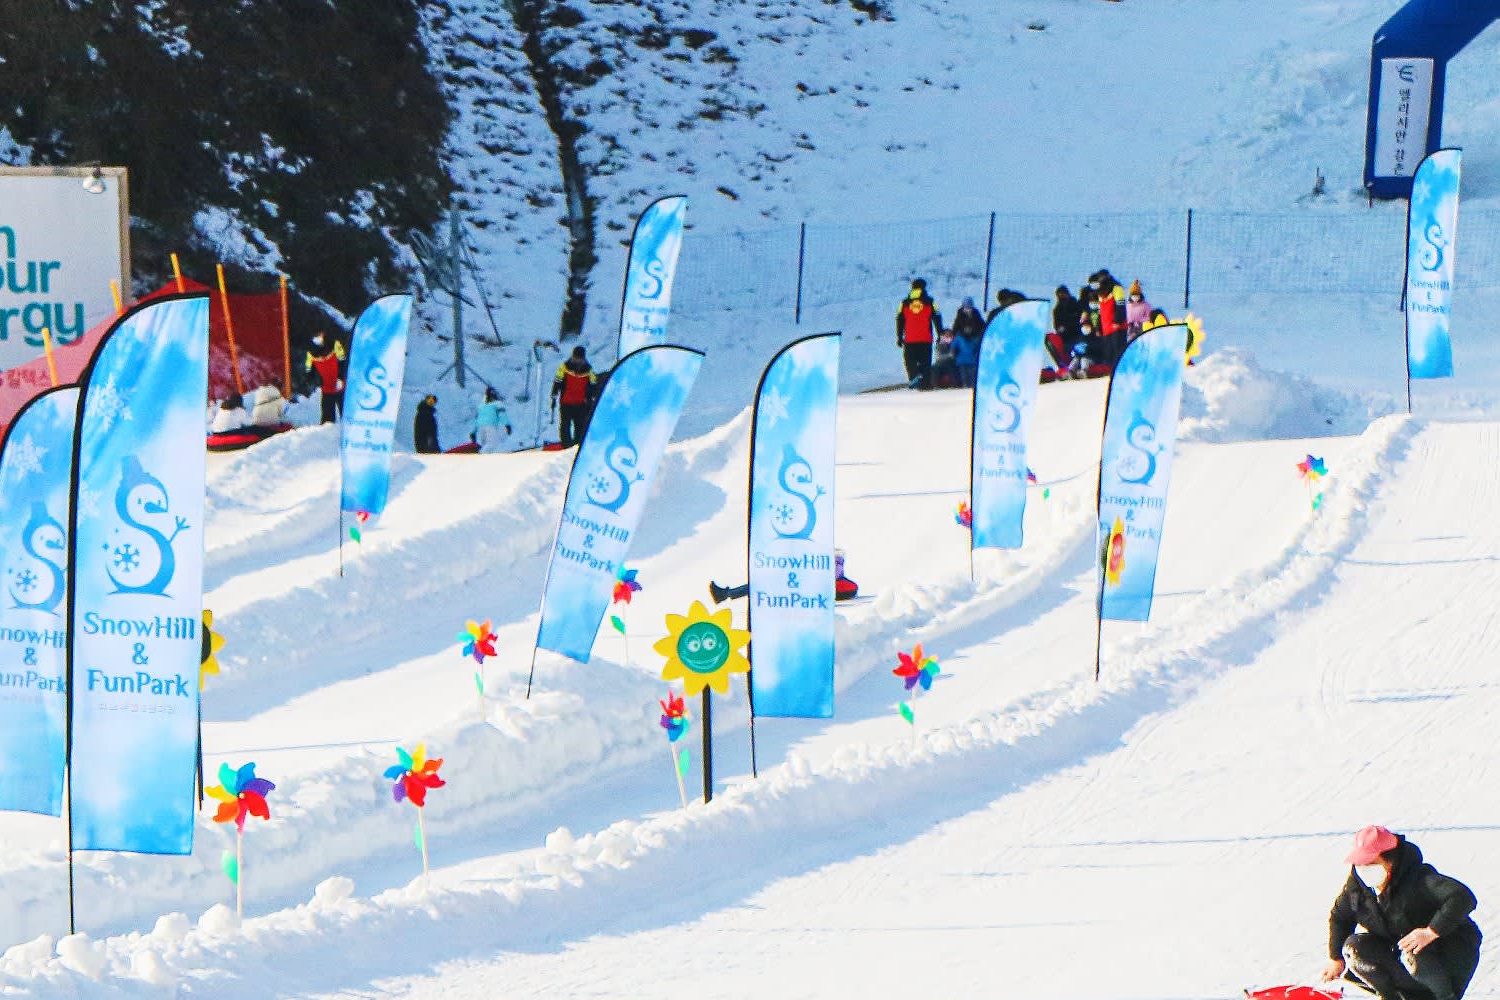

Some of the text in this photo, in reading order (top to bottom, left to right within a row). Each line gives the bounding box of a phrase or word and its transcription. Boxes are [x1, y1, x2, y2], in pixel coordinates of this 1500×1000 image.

[583, 533, 594, 549] &
[755, 551, 830, 571] SnowHill
[787, 571, 800, 589] &
[756, 591, 828, 609] FunPark
[83, 611, 196, 640] SnowHill
[22, 647, 38, 666] &
[132, 642, 149, 665] &
[87, 669, 189, 697] FunPark
